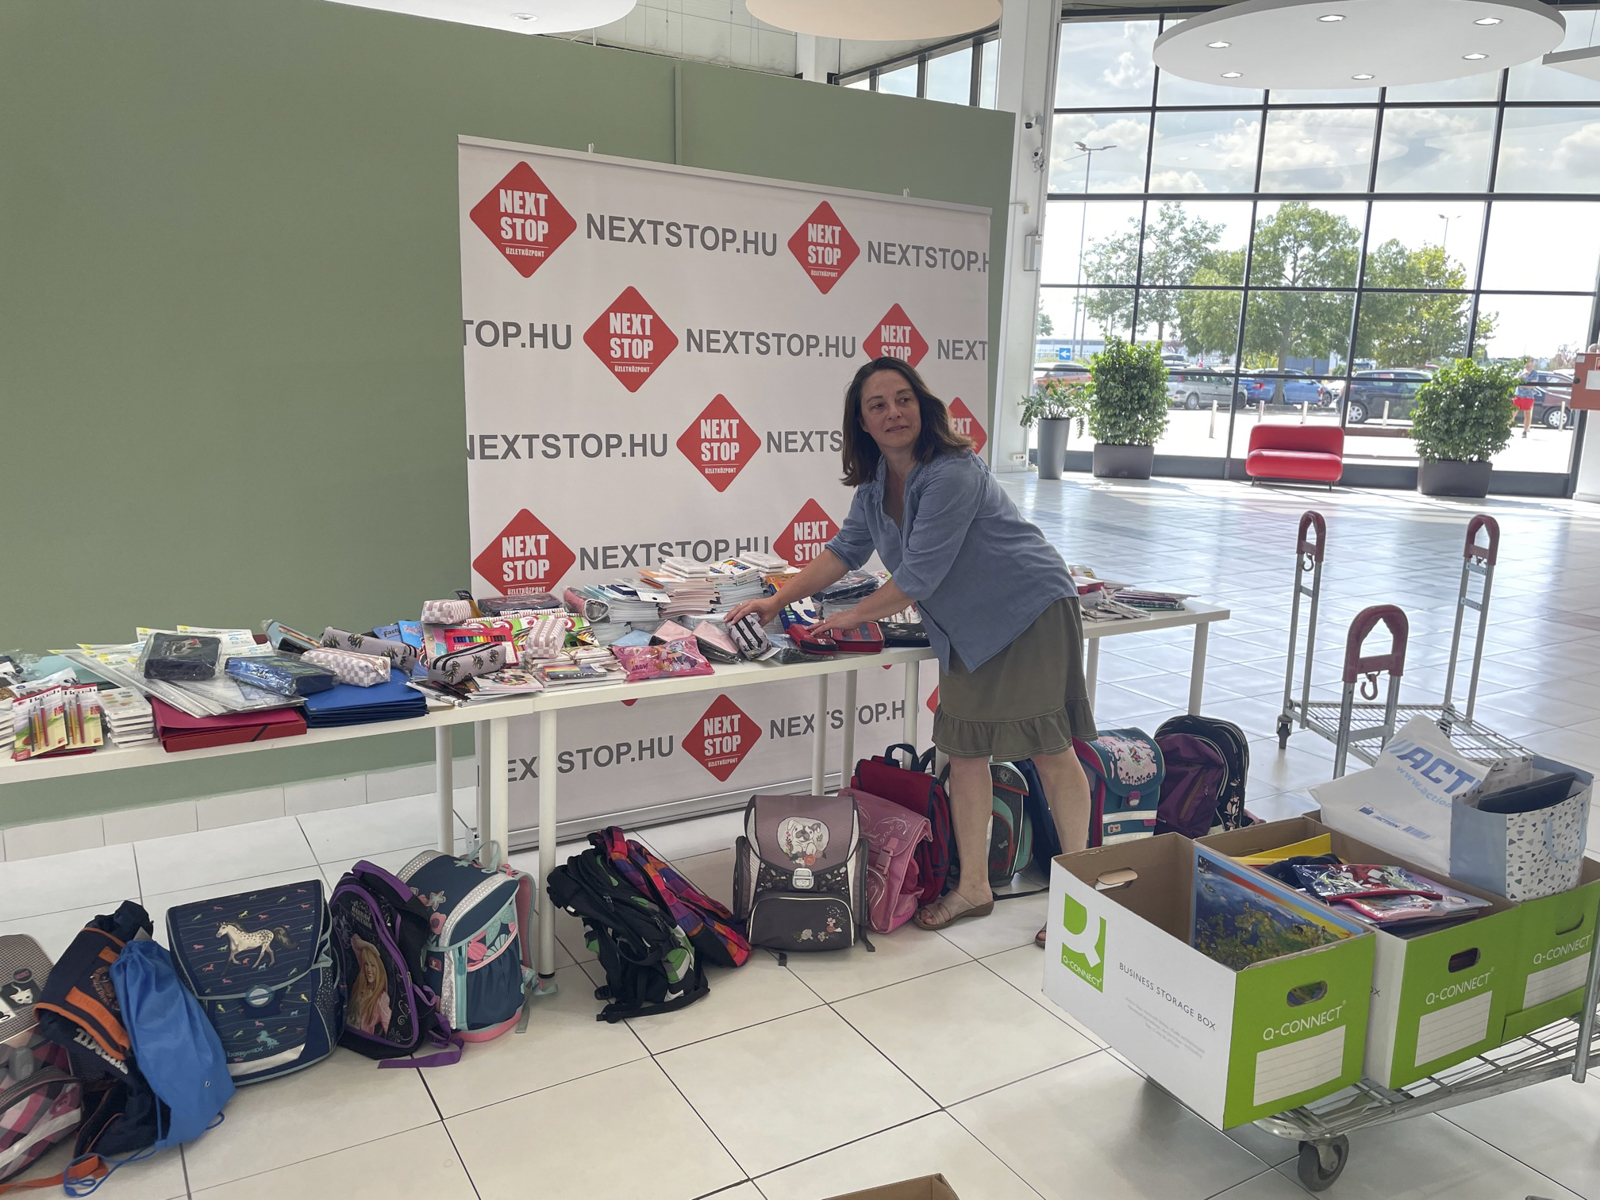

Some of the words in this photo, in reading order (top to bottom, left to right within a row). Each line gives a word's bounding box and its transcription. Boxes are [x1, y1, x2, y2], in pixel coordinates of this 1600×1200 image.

[499, 189, 548, 217] NEXT
[500, 216, 549, 242] STOP
[586, 213, 777, 256] NEXTSTOP.HU
[807, 222, 842, 245] NEXT
[807, 245, 842, 265] STOP
[609, 312, 653, 335] NEXT
[881, 325, 912, 344] NEXT
[610, 337, 654, 360] STOP
[686, 328, 856, 358] NEXTSTOP.HU
[937, 339, 988, 361] NEXT
[700, 419, 739, 439] NEXT
[951, 417, 973, 435] EXT
[701, 441, 740, 462] STOP
[793, 520, 829, 541] NEXT
[501, 534, 549, 559] NEXT
[502, 558, 550, 582] STOP
[703, 714, 741, 737] NEXT
[704, 734, 741, 757] STOP
[1533, 933, 1592, 966] Q-CONNECT
[1062, 955, 1101, 987] Q-CONNECT
[1119, 961, 1154, 991] BUSINESS
[1156, 986, 1195, 1018] STORAGE
[1197, 1012, 1216, 1032] BOX
[1425, 971, 1492, 1006] Q-CONNECT
[1262, 1005, 1343, 1042] Q-CONNECT
